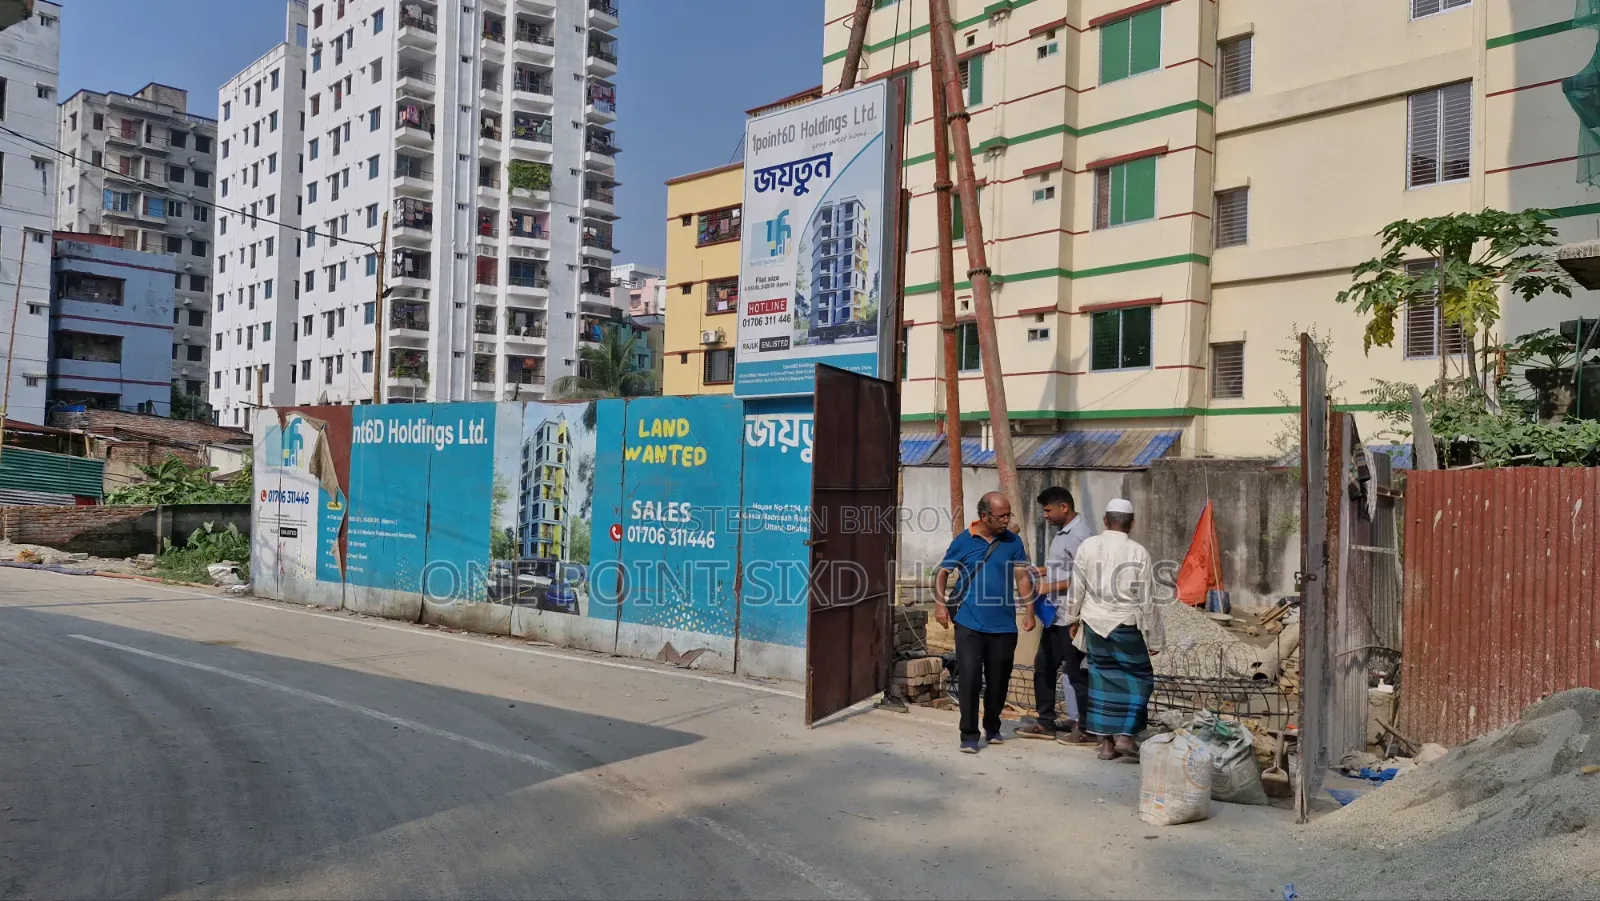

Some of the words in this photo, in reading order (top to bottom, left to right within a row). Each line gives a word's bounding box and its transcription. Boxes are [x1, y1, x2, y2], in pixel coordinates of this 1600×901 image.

[752, 124, 796, 156] 1point6D
[800, 114, 848, 140] Holdings
[854, 101, 877, 126] Ltd.
[811, 141, 827, 151] your
[828, 135, 847, 146] sweet
[753, 151, 833, 197] জয়তুন
[755, 276, 767, 284] Flat
[767, 274, 780, 282] size
[748, 299, 786, 314] HOTLINE
[742, 316, 763, 328] 01706
[764, 315, 776, 326] 311
[778, 313, 792, 324] 446
[742, 341, 759, 350] RAJUK
[761, 339, 789, 349] ENLISTED
[388, 418, 454, 452] Holdings
[458, 417, 488, 445] Ltd.
[638, 417, 690, 439] LAND
[624, 443, 707, 468] WANTED
[268, 490, 286, 504] 01706
[287, 490, 310, 504] 311446
[631, 499, 692, 523] SALES
[752, 502, 773, 511] House
[793, 514, 811, 523] Road
[627, 525, 666, 545] 01706
[668, 527, 715, 549] 311446
